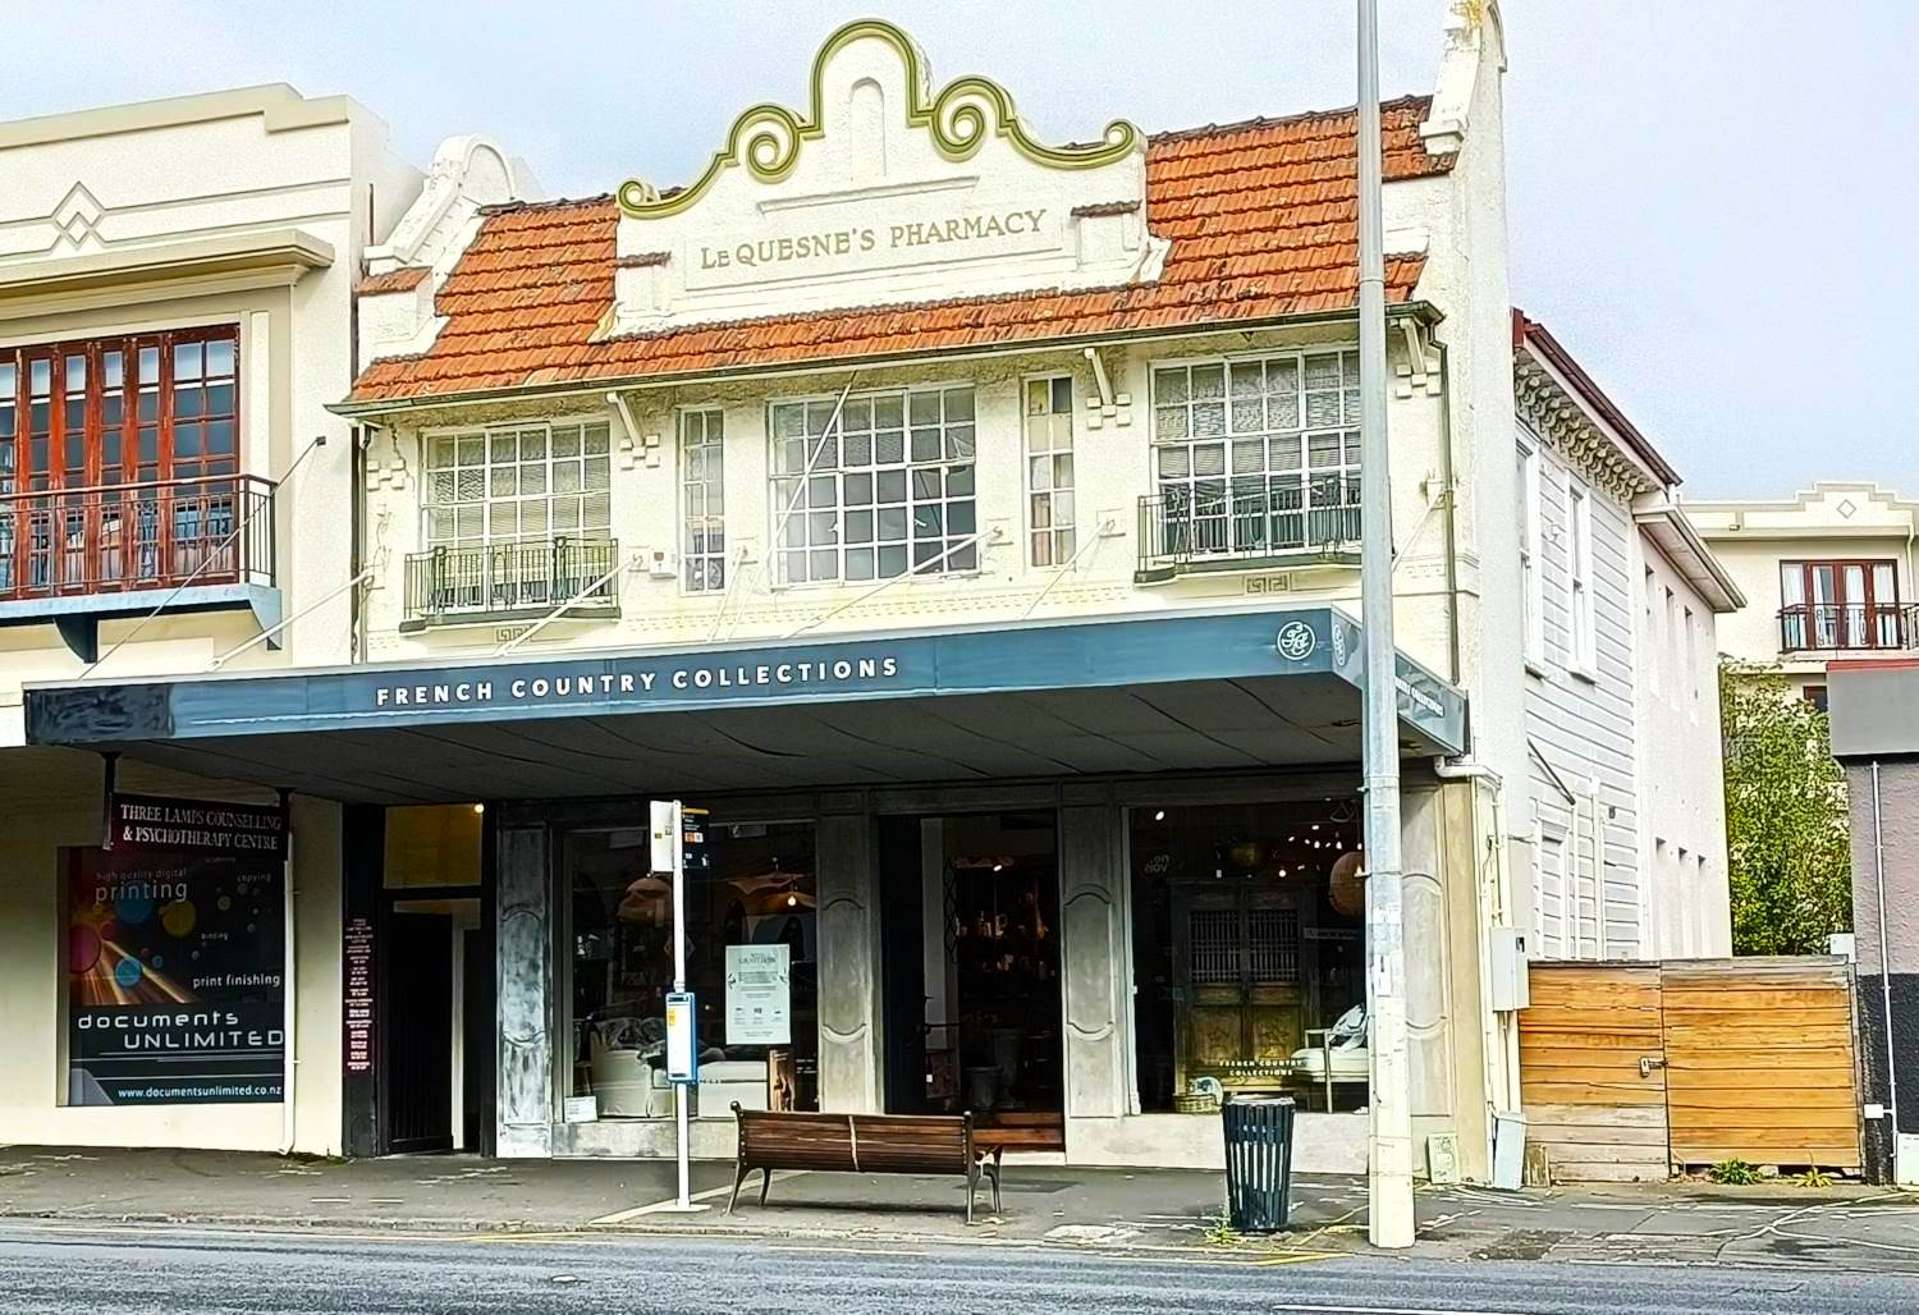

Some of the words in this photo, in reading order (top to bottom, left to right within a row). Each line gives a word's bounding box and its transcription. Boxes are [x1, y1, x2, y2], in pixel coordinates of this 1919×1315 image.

[735, 229, 876, 267] QUESNE'S
[890, 208, 1048, 249] PHARMACY
[377, 682, 493, 707] FRENCH
[511, 671, 655, 699] COUNTRY
[673, 657, 898, 690] COLLECTIONS
[120, 803, 162, 821] THREE
[164, 807, 205, 825] LAMPS
[206, 811, 282, 831] COUNSELLING
[122, 825, 133, 841] &
[135, 826, 232, 848] PSYCHOTHERAPY
[233, 833, 279, 850] CENTRE
[95, 880, 187, 903] printing
[192, 976, 222, 989] print
[225, 973, 281, 988] finishing
[78, 1011, 238, 1029] documents
[124, 1030, 284, 1049] UNLIMITED
[118, 1085, 282, 1098] www.documentsunlimited.co.nz
